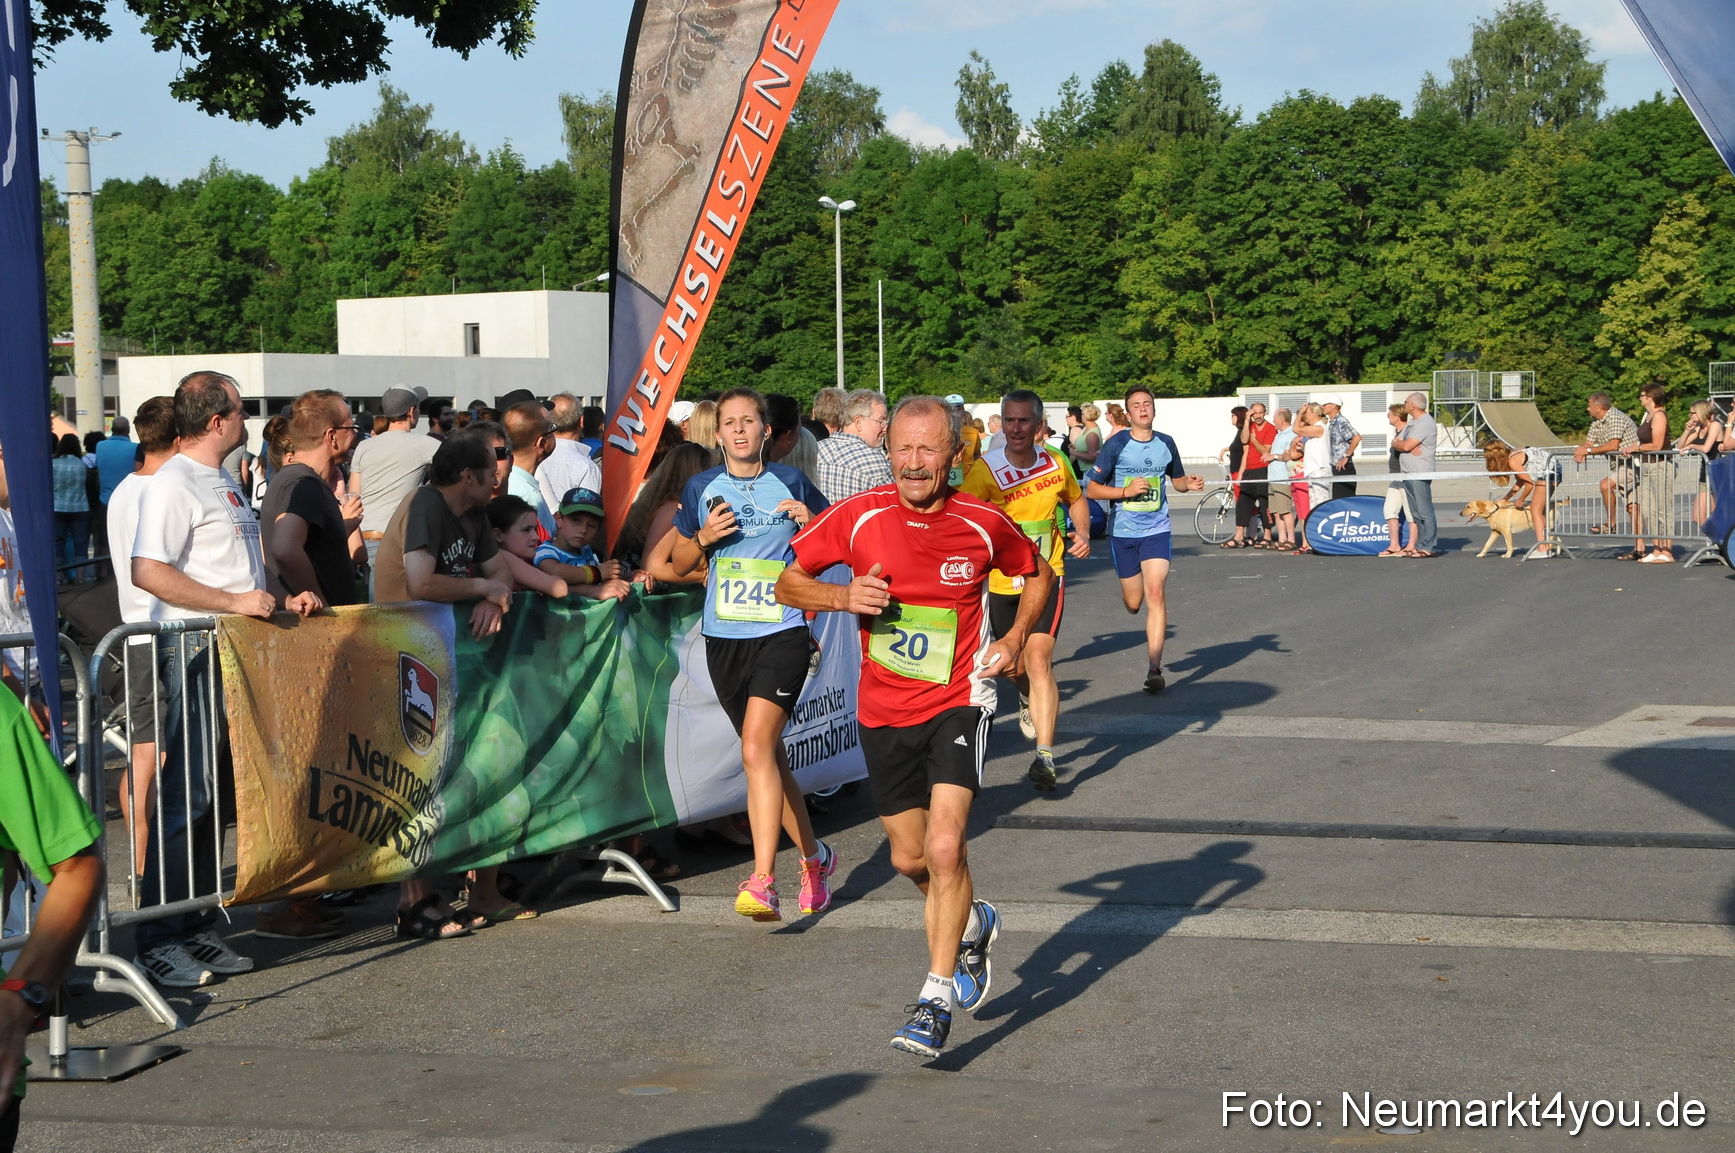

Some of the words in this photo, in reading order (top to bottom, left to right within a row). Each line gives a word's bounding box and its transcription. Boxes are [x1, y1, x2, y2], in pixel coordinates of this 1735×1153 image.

[1003, 487, 1034, 504] MAX
[1034, 474, 1064, 492] BÖGL
[1332, 521, 1391, 537] Fische
[1338, 535, 1391, 543] AUTOMOBIL
[720, 579, 778, 607] 1245
[889, 628, 929, 661] 20
[789, 686, 846, 728] Neumarkter
[787, 715, 858, 772] ammsbräu
